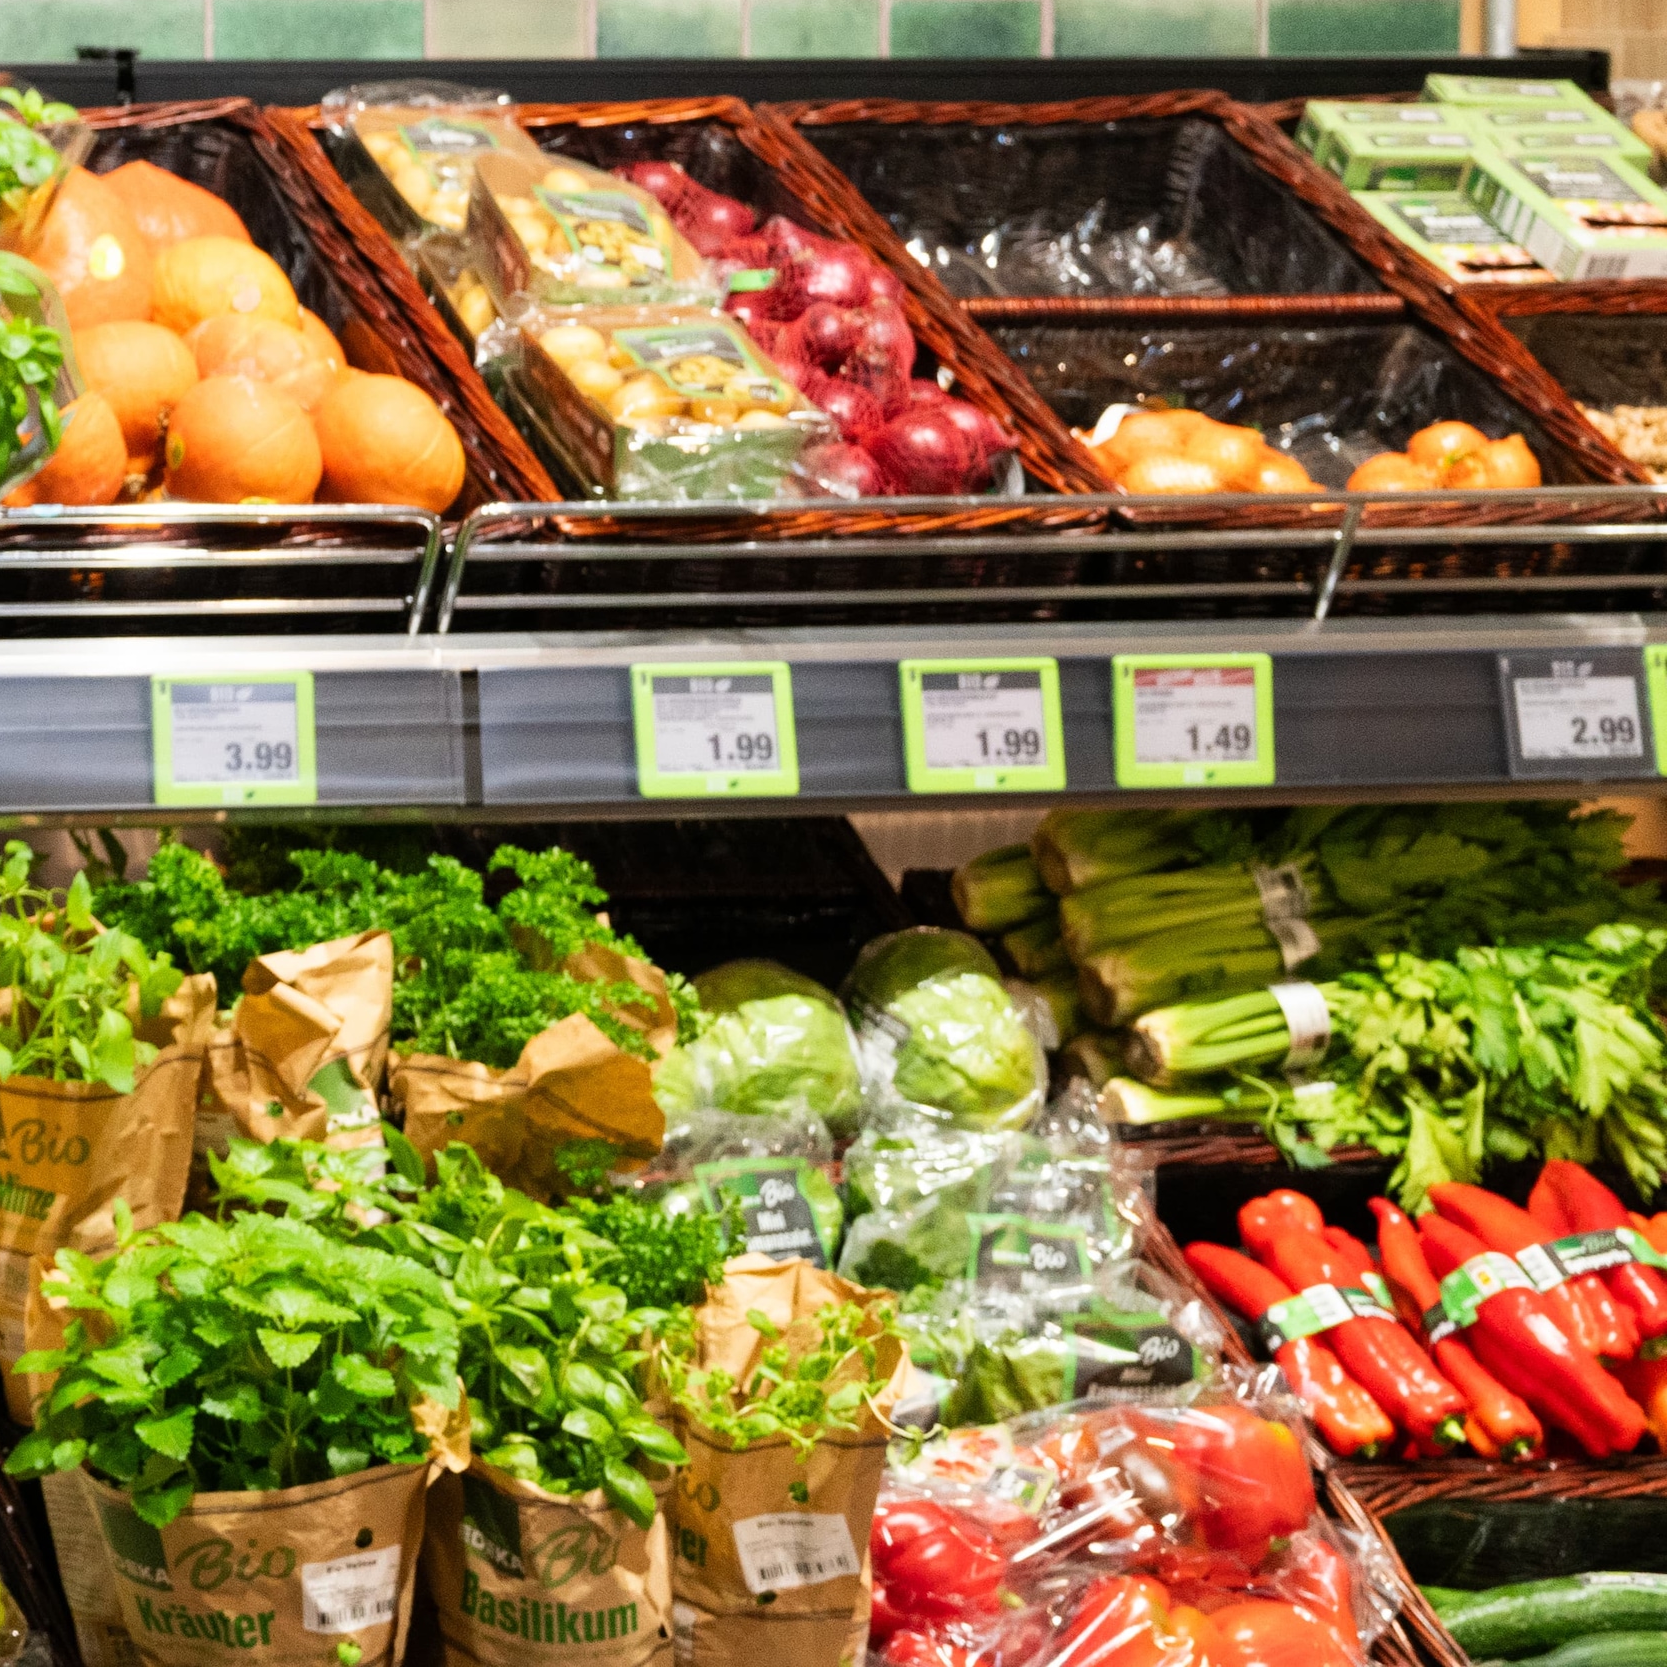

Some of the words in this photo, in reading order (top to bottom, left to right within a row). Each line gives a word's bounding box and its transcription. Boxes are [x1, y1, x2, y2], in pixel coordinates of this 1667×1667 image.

[977, 729, 1040, 759] 1.99
[1186, 723, 1251, 751] 1.49
[1572, 716, 1635, 745] 2.99
[225, 742, 292, 771] 3.99
[708, 733, 772, 761] 1.99
[11, 1118, 91, 1166] Bio
[759, 1178, 796, 1209] Bio
[1029, 1242, 1067, 1271] Bio
[1139, 1335, 1182, 1366] Bio
[174, 1536, 297, 1591] Bio
[135, 1593, 276, 1649] Kräuter
[460, 1567, 639, 1645] Basilikum
